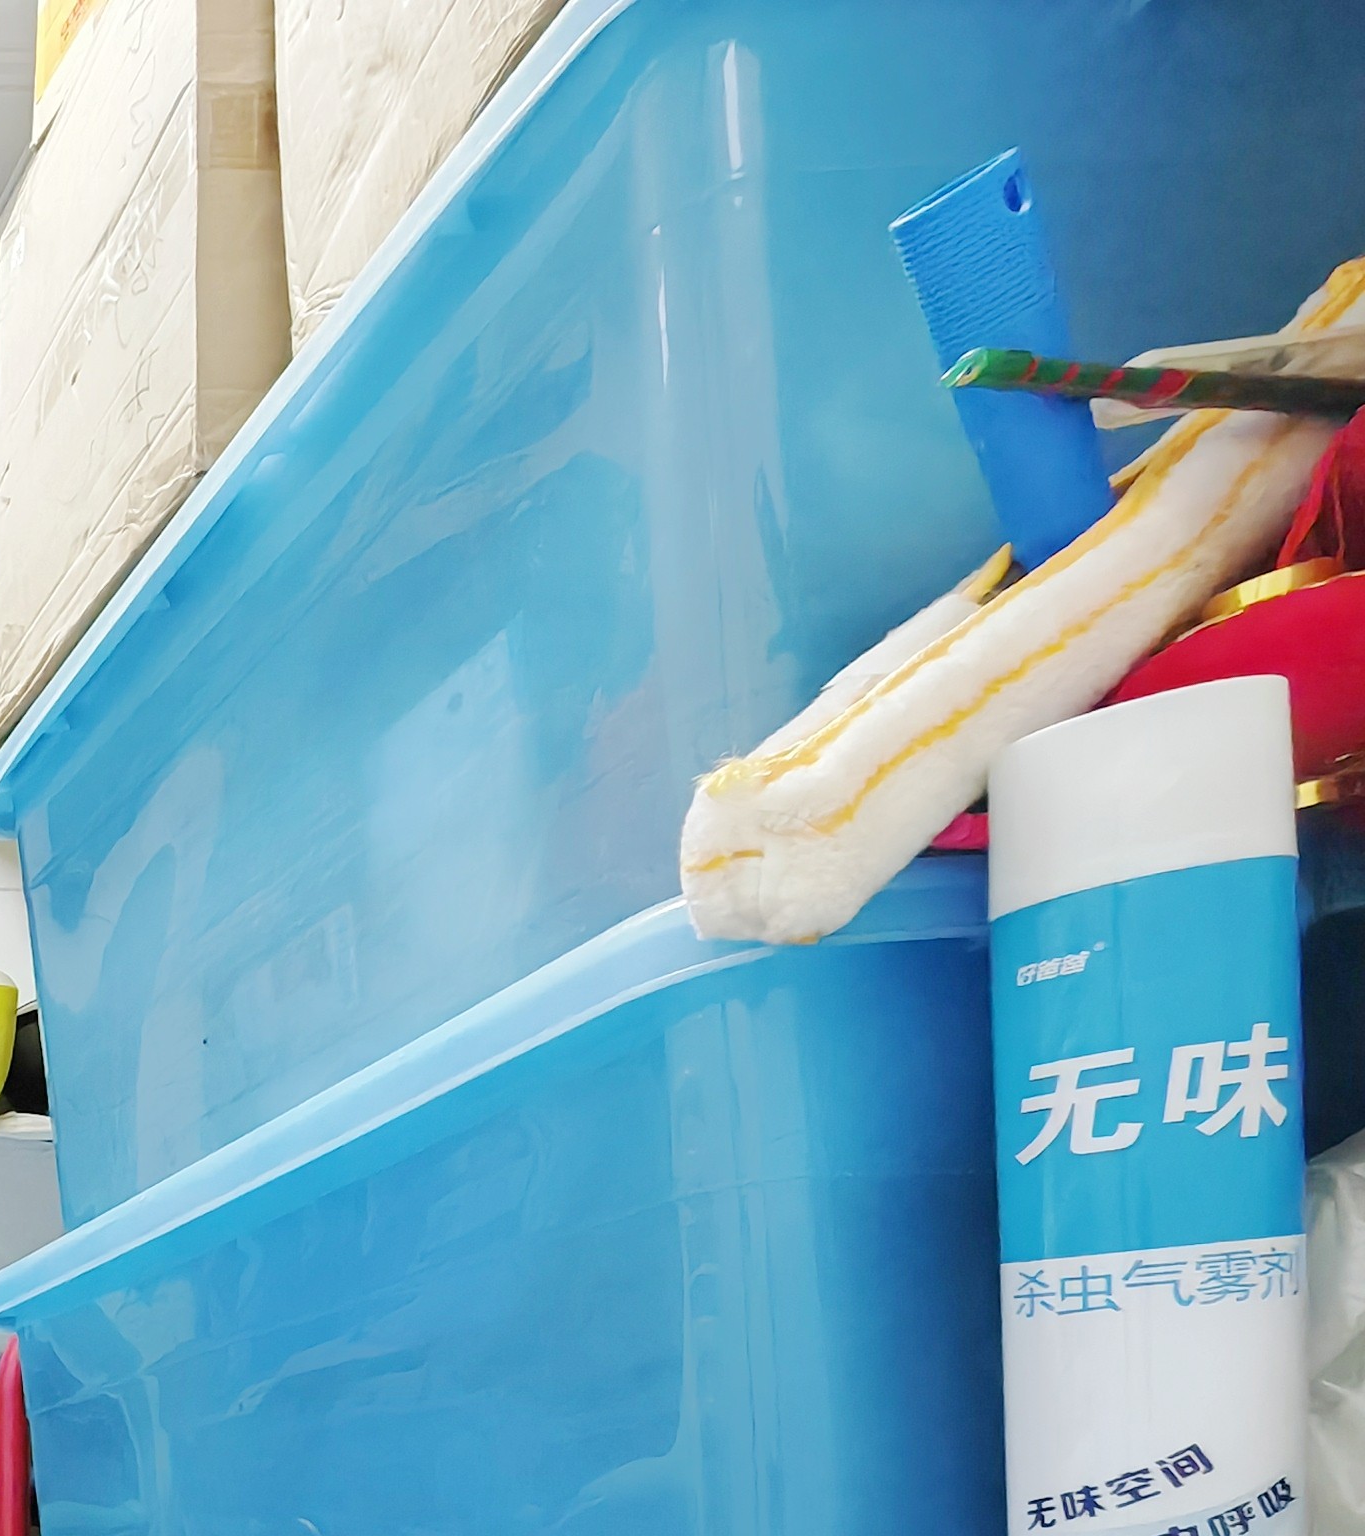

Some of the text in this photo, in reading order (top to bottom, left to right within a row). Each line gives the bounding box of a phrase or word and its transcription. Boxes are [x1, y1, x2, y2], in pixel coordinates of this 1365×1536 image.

[1014, 1022, 1289, 1166] 无味
[1013, 1246, 1300, 1319] 杀虫气雾剂
[1025, 1443, 1216, 1531] 无味空间
